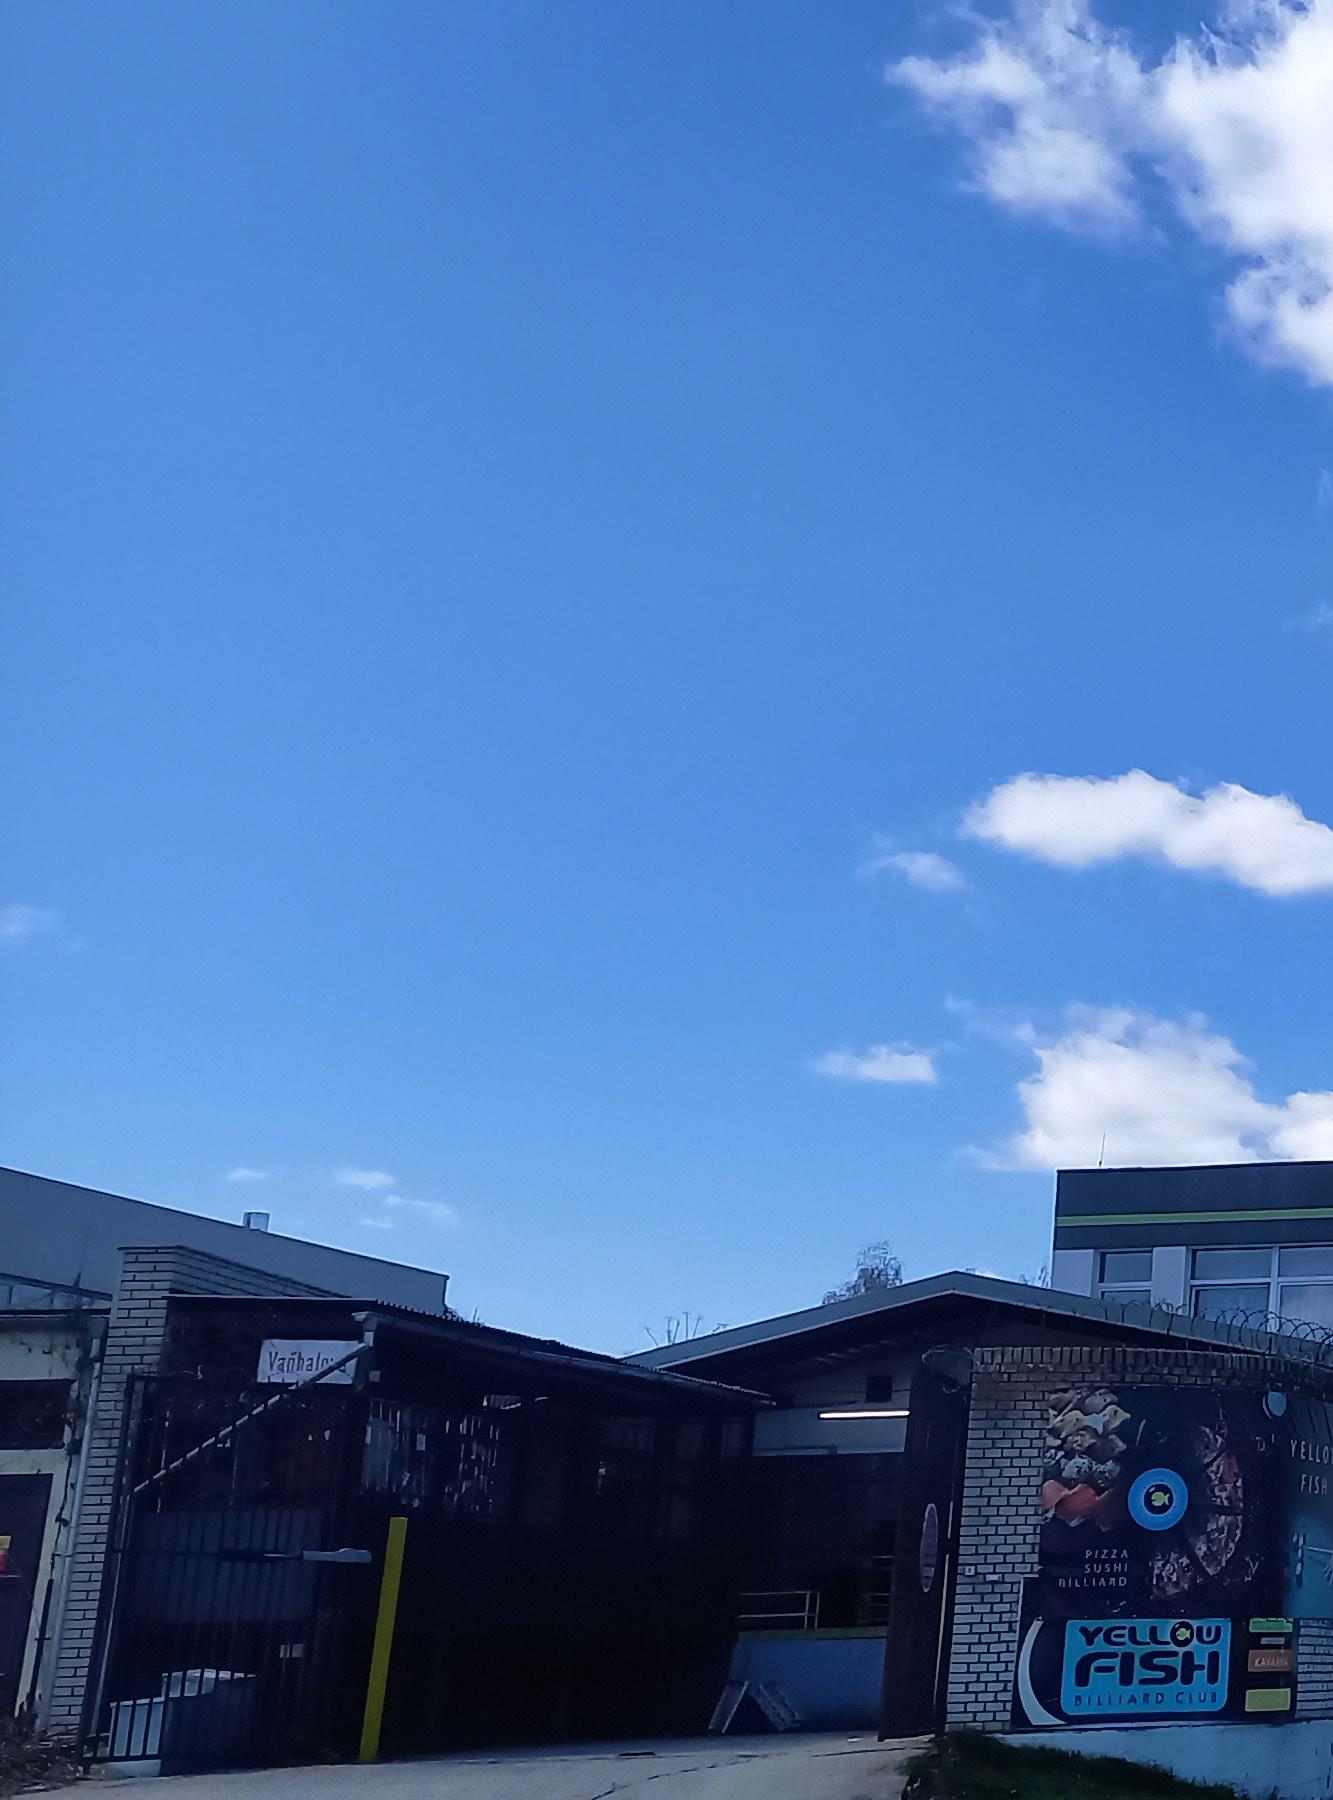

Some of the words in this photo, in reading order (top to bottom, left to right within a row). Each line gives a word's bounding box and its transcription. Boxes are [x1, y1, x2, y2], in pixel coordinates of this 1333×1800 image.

[268, 1351, 347, 1374] Vaňhalo
[1300, 1473, 1328, 1496] FISH
[1085, 1549, 1129, 1559] PIZZA
[1084, 1562, 1128, 1574] SUSHI
[1058, 1576, 1127, 1588] BILLIARD
[1078, 1621, 1222, 1648] YELLOW
[1074, 1650, 1220, 1688] FISH
[1074, 1692, 1165, 1707] BILLIARD
[1175, 1691, 1217, 1705] CLUB
